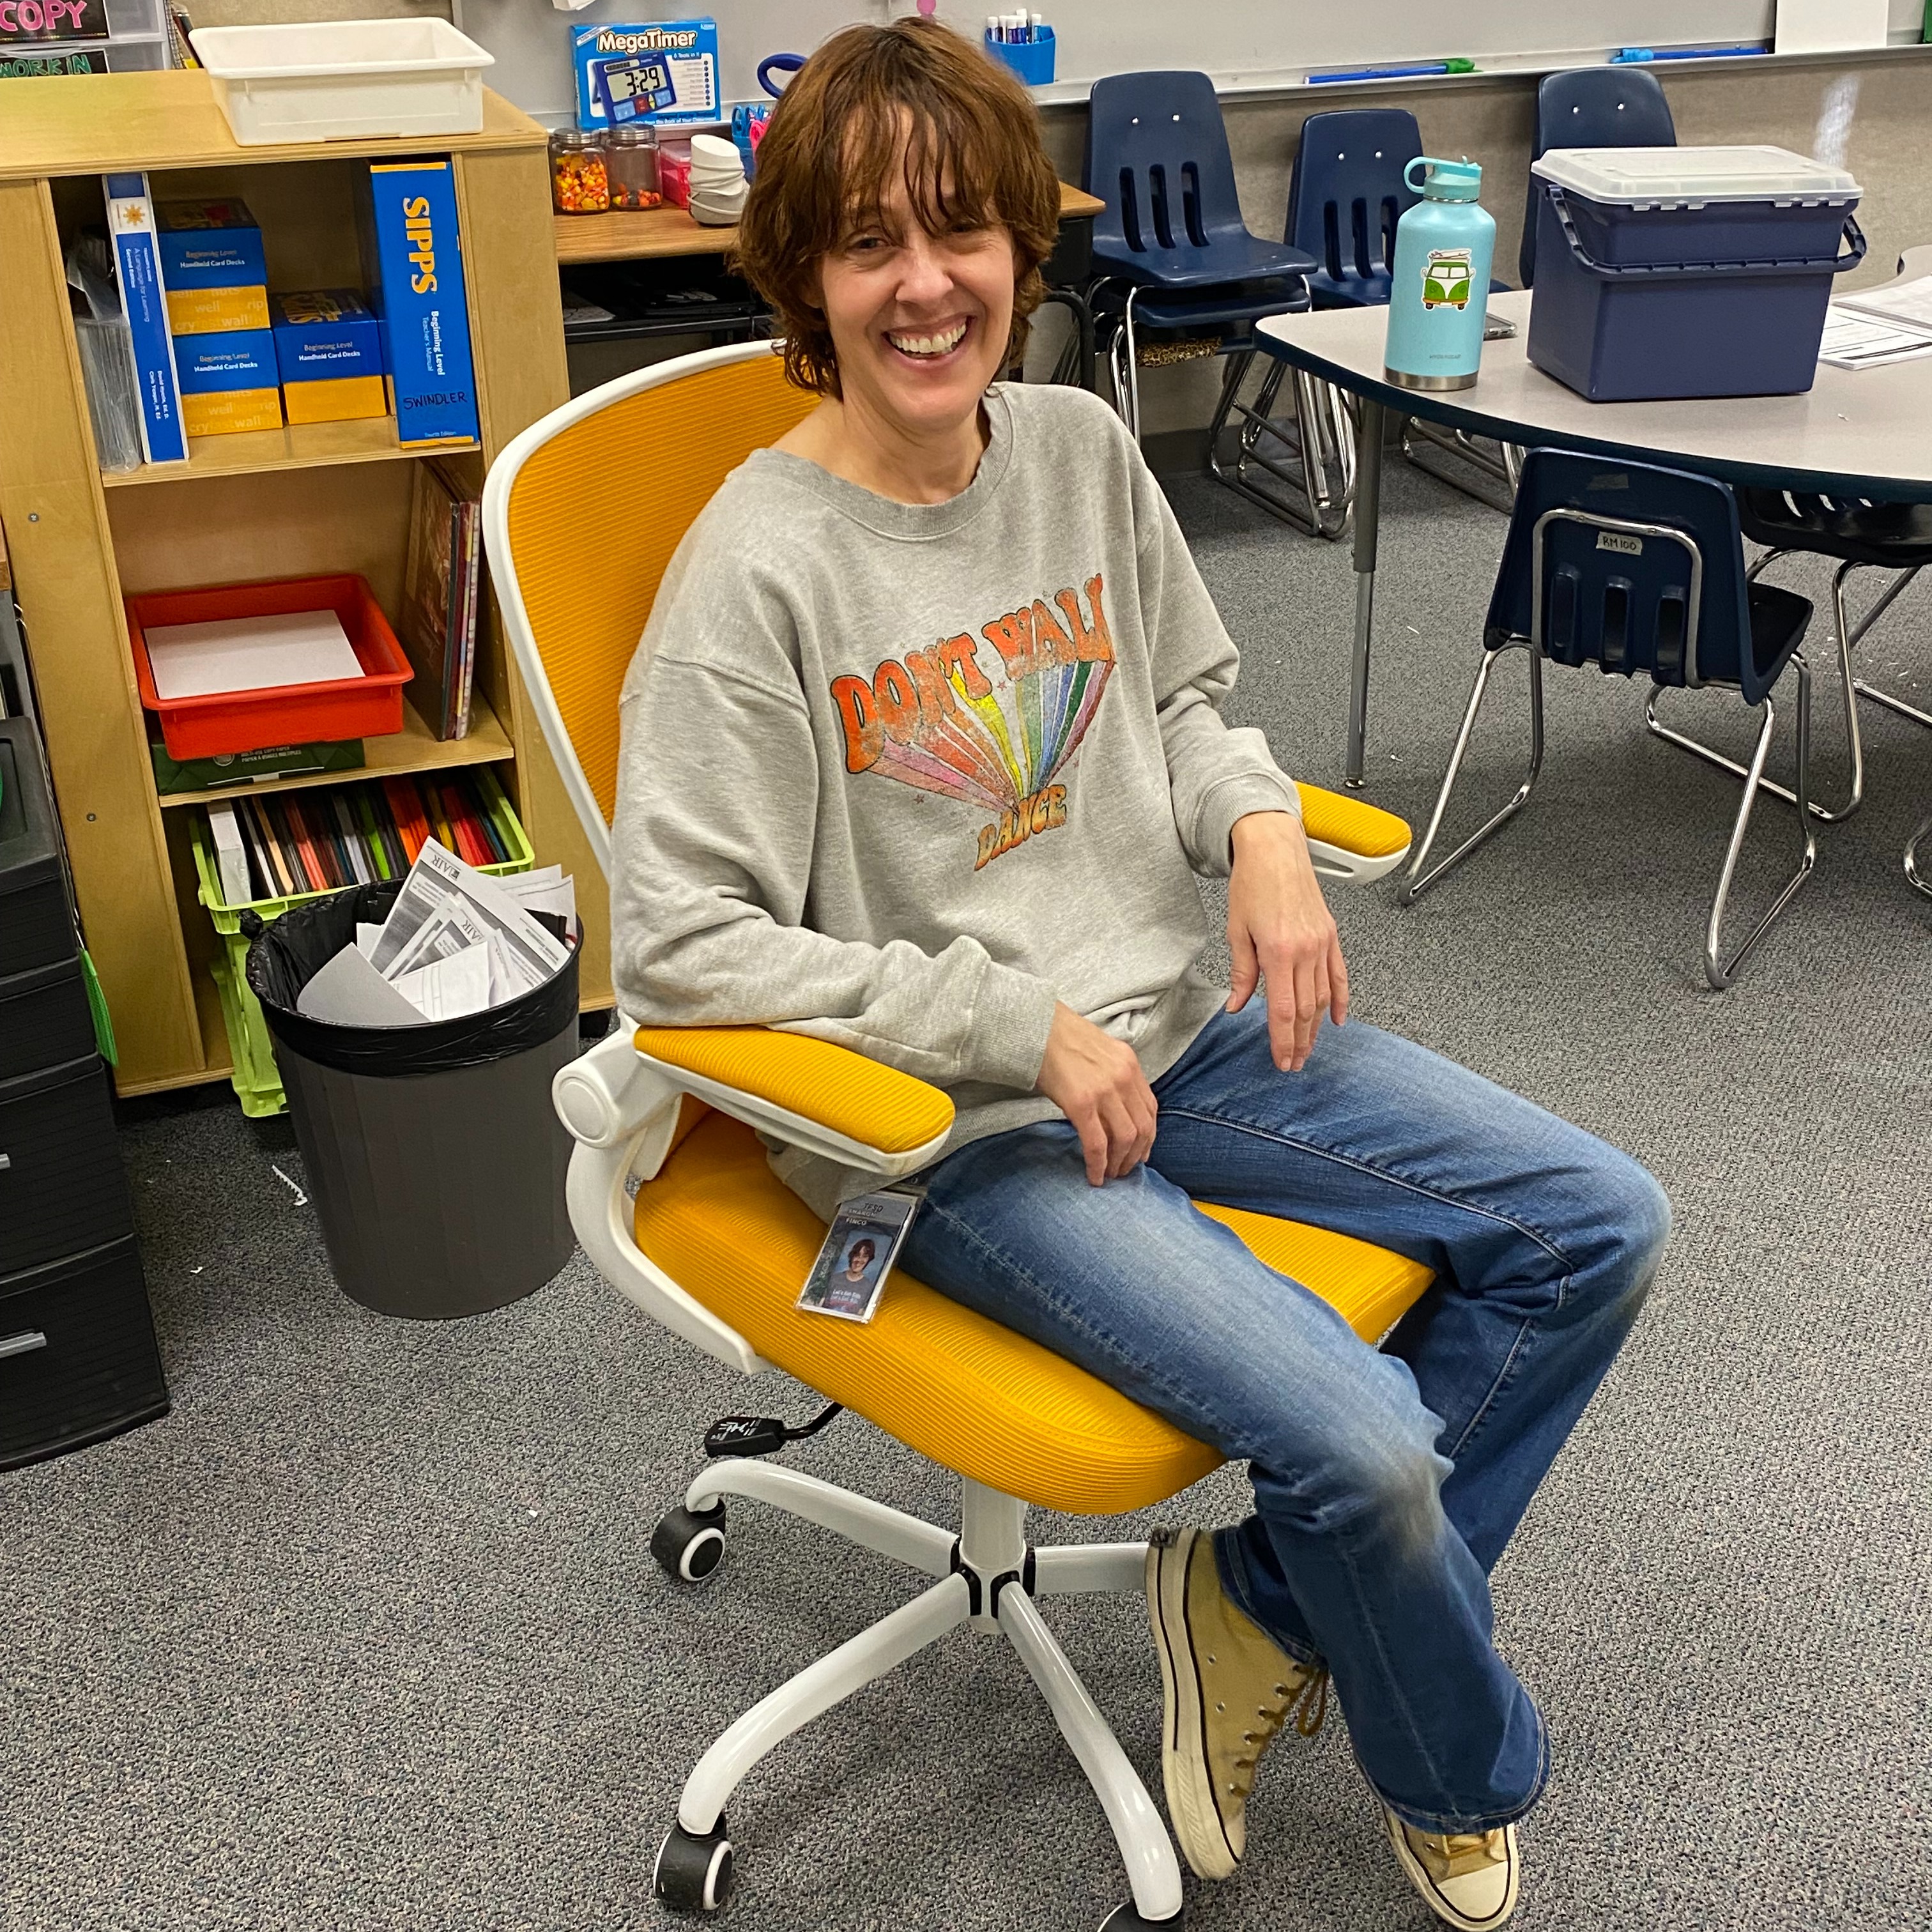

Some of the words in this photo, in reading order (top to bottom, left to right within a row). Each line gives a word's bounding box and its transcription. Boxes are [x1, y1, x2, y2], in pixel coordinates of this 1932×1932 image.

[0, 0, 87, 31] COPY
[598, 29, 696, 54] MegaTimer
[625, 66, 660, 96] 3:29
[403, 197, 437, 294] SIPPS
[431, 310, 443, 353] Beginning
[194, 364, 224, 372] Handheld
[436, 353, 446, 376] Level
[403, 391, 467, 410] SWINDLER
[1602, 535, 1618, 548] RM
[1620, 540, 1637, 551] 100
[831, 632, 992, 774] DON'T
[974, 784, 1067, 871] DANCE
